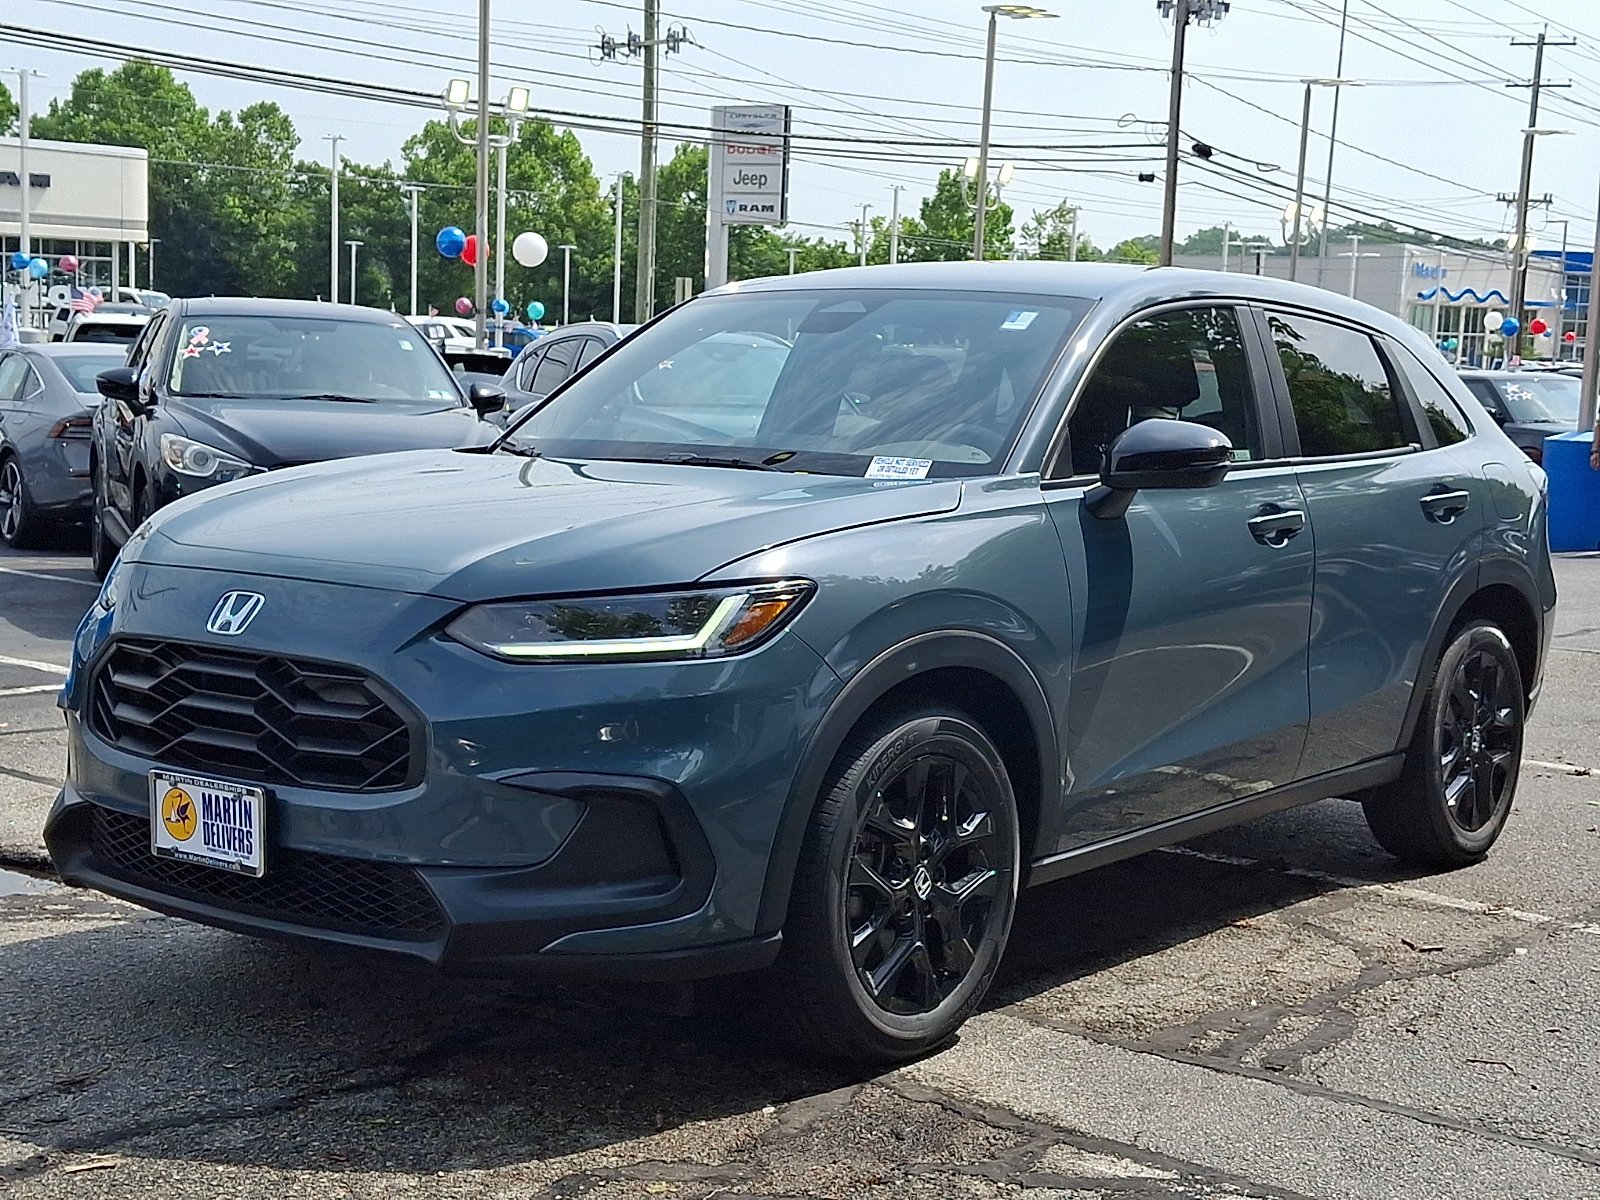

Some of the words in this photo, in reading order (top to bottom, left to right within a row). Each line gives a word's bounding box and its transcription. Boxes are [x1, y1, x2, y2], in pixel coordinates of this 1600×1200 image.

[727, 145, 777, 155] DODGE
[733, 169, 768, 189] Jeep
[738, 204, 775, 213] RAM
[162, 773, 193, 785] MARTIN
[193, 779, 247, 795] DEALERSHIPS
[201, 792, 253, 829] MARTIN
[202, 821, 253, 855] DELIVERS
